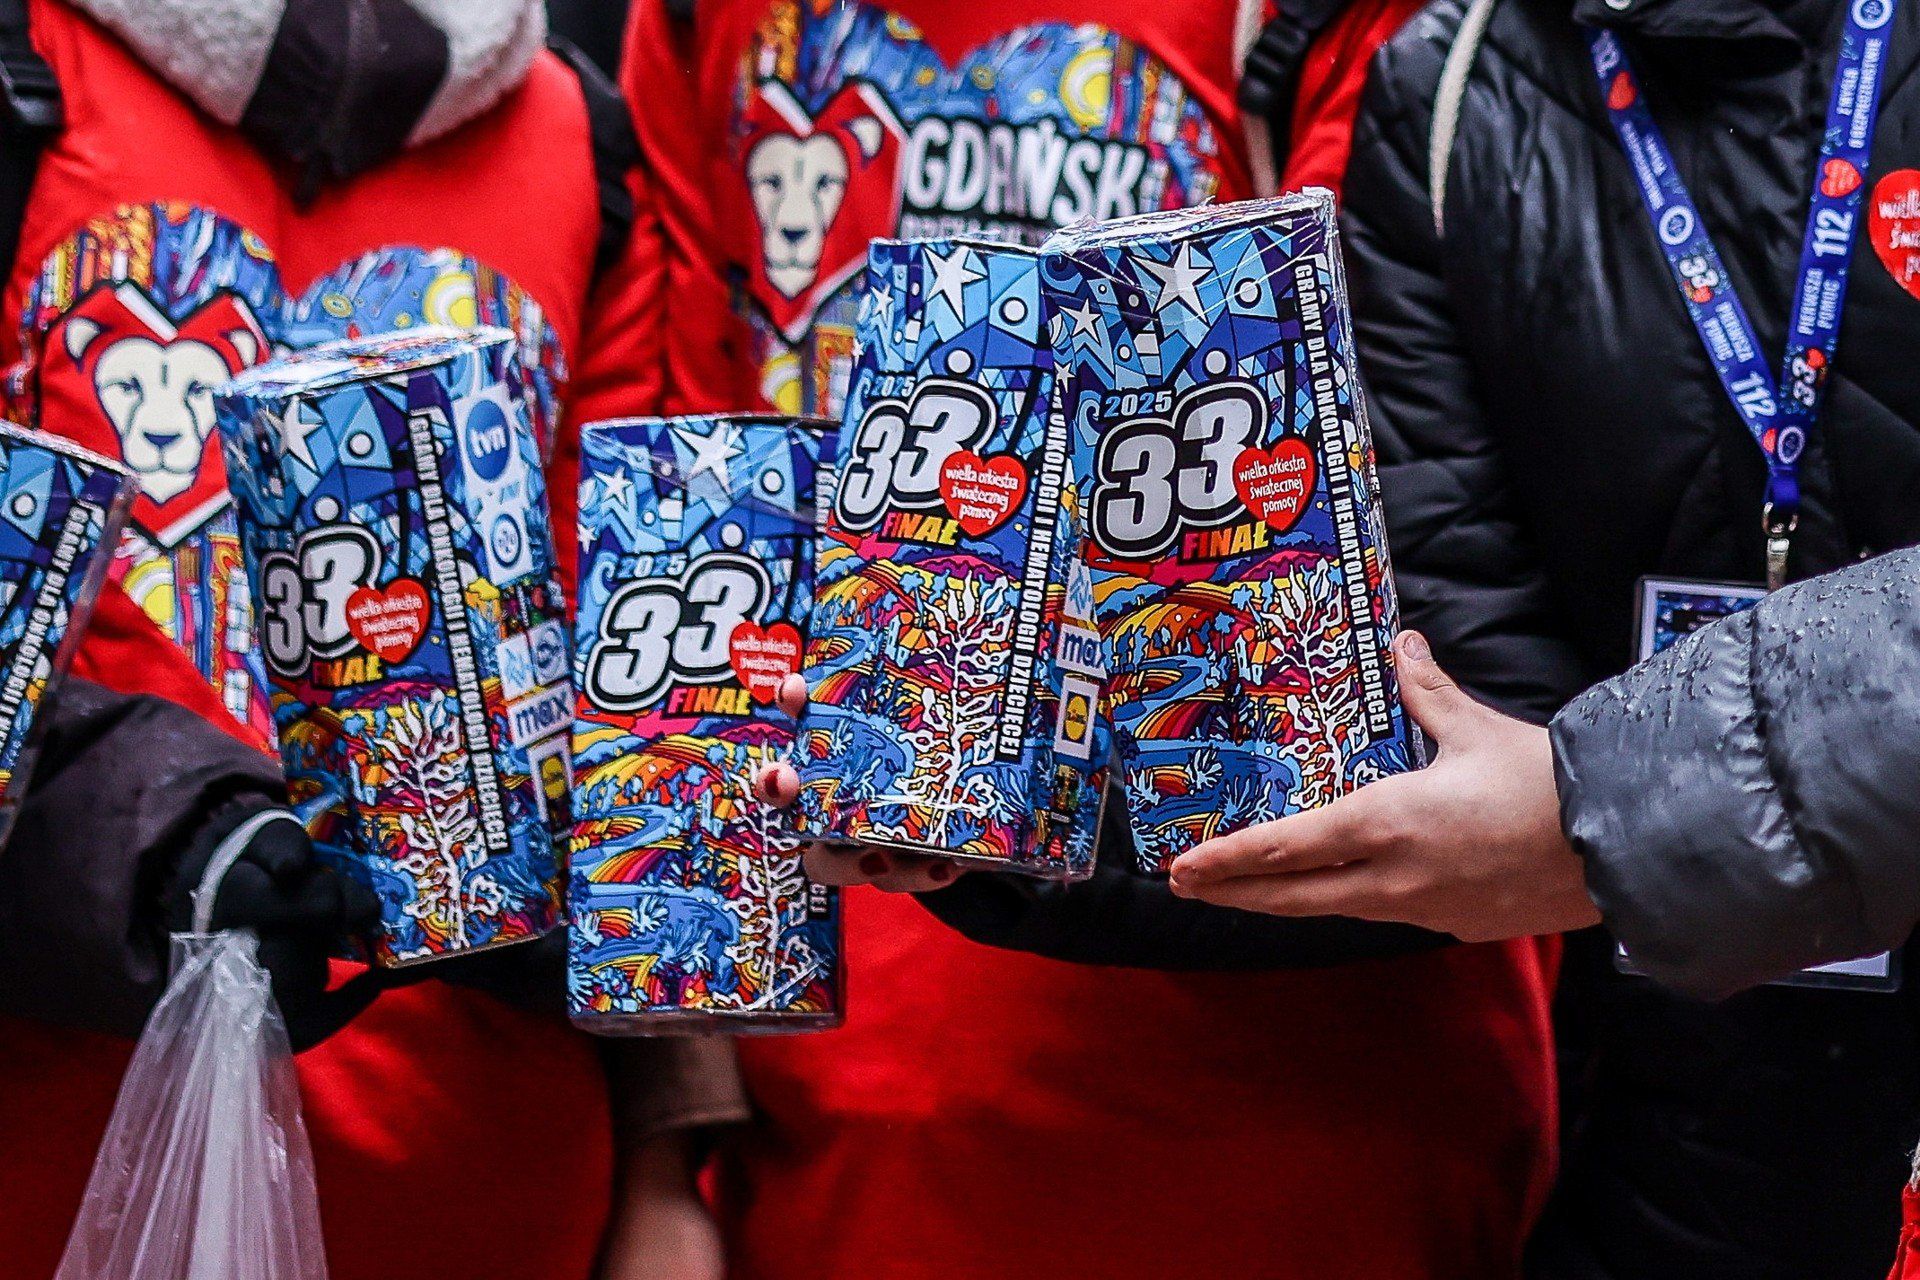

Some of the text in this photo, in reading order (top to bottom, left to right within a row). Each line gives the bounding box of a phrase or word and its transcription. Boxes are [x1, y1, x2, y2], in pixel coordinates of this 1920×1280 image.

[905, 116, 1145, 226] GDAŃSK
[1812, 208, 1853, 257] 112
[871, 375, 916, 398] 2025
[1104, 390, 1173, 417] 2025
[1731, 371, 1776, 419] 112
[470, 425, 507, 458] tvn
[839, 386, 987, 522] 33
[946, 462, 1018, 490] wielka orkiestra
[1100, 390, 1258, 549] 33
[1239, 454, 1306, 482] wielka orkiestra
[1250, 474, 1303, 500] świątecznej
[1295, 264, 1389, 734] GRAMY DLA ONKOLOGII I HEMATOLOGII DZIECIĘCEJ
[959, 503, 998, 525] pomocy
[1263, 496, 1297, 518] pomocy
[881, 513, 960, 545] FINAŁ
[1183, 521, 1269, 559] FINAŁ
[617, 553, 688, 578] 2025
[263, 532, 373, 669] 33
[998, 413, 1068, 755] ONKOLOGII I HEMATOLOGII DZIECIĘCEJ
[592, 560, 763, 703] 33
[516, 691, 570, 737] max
[667, 686, 751, 715] FINAŁ
